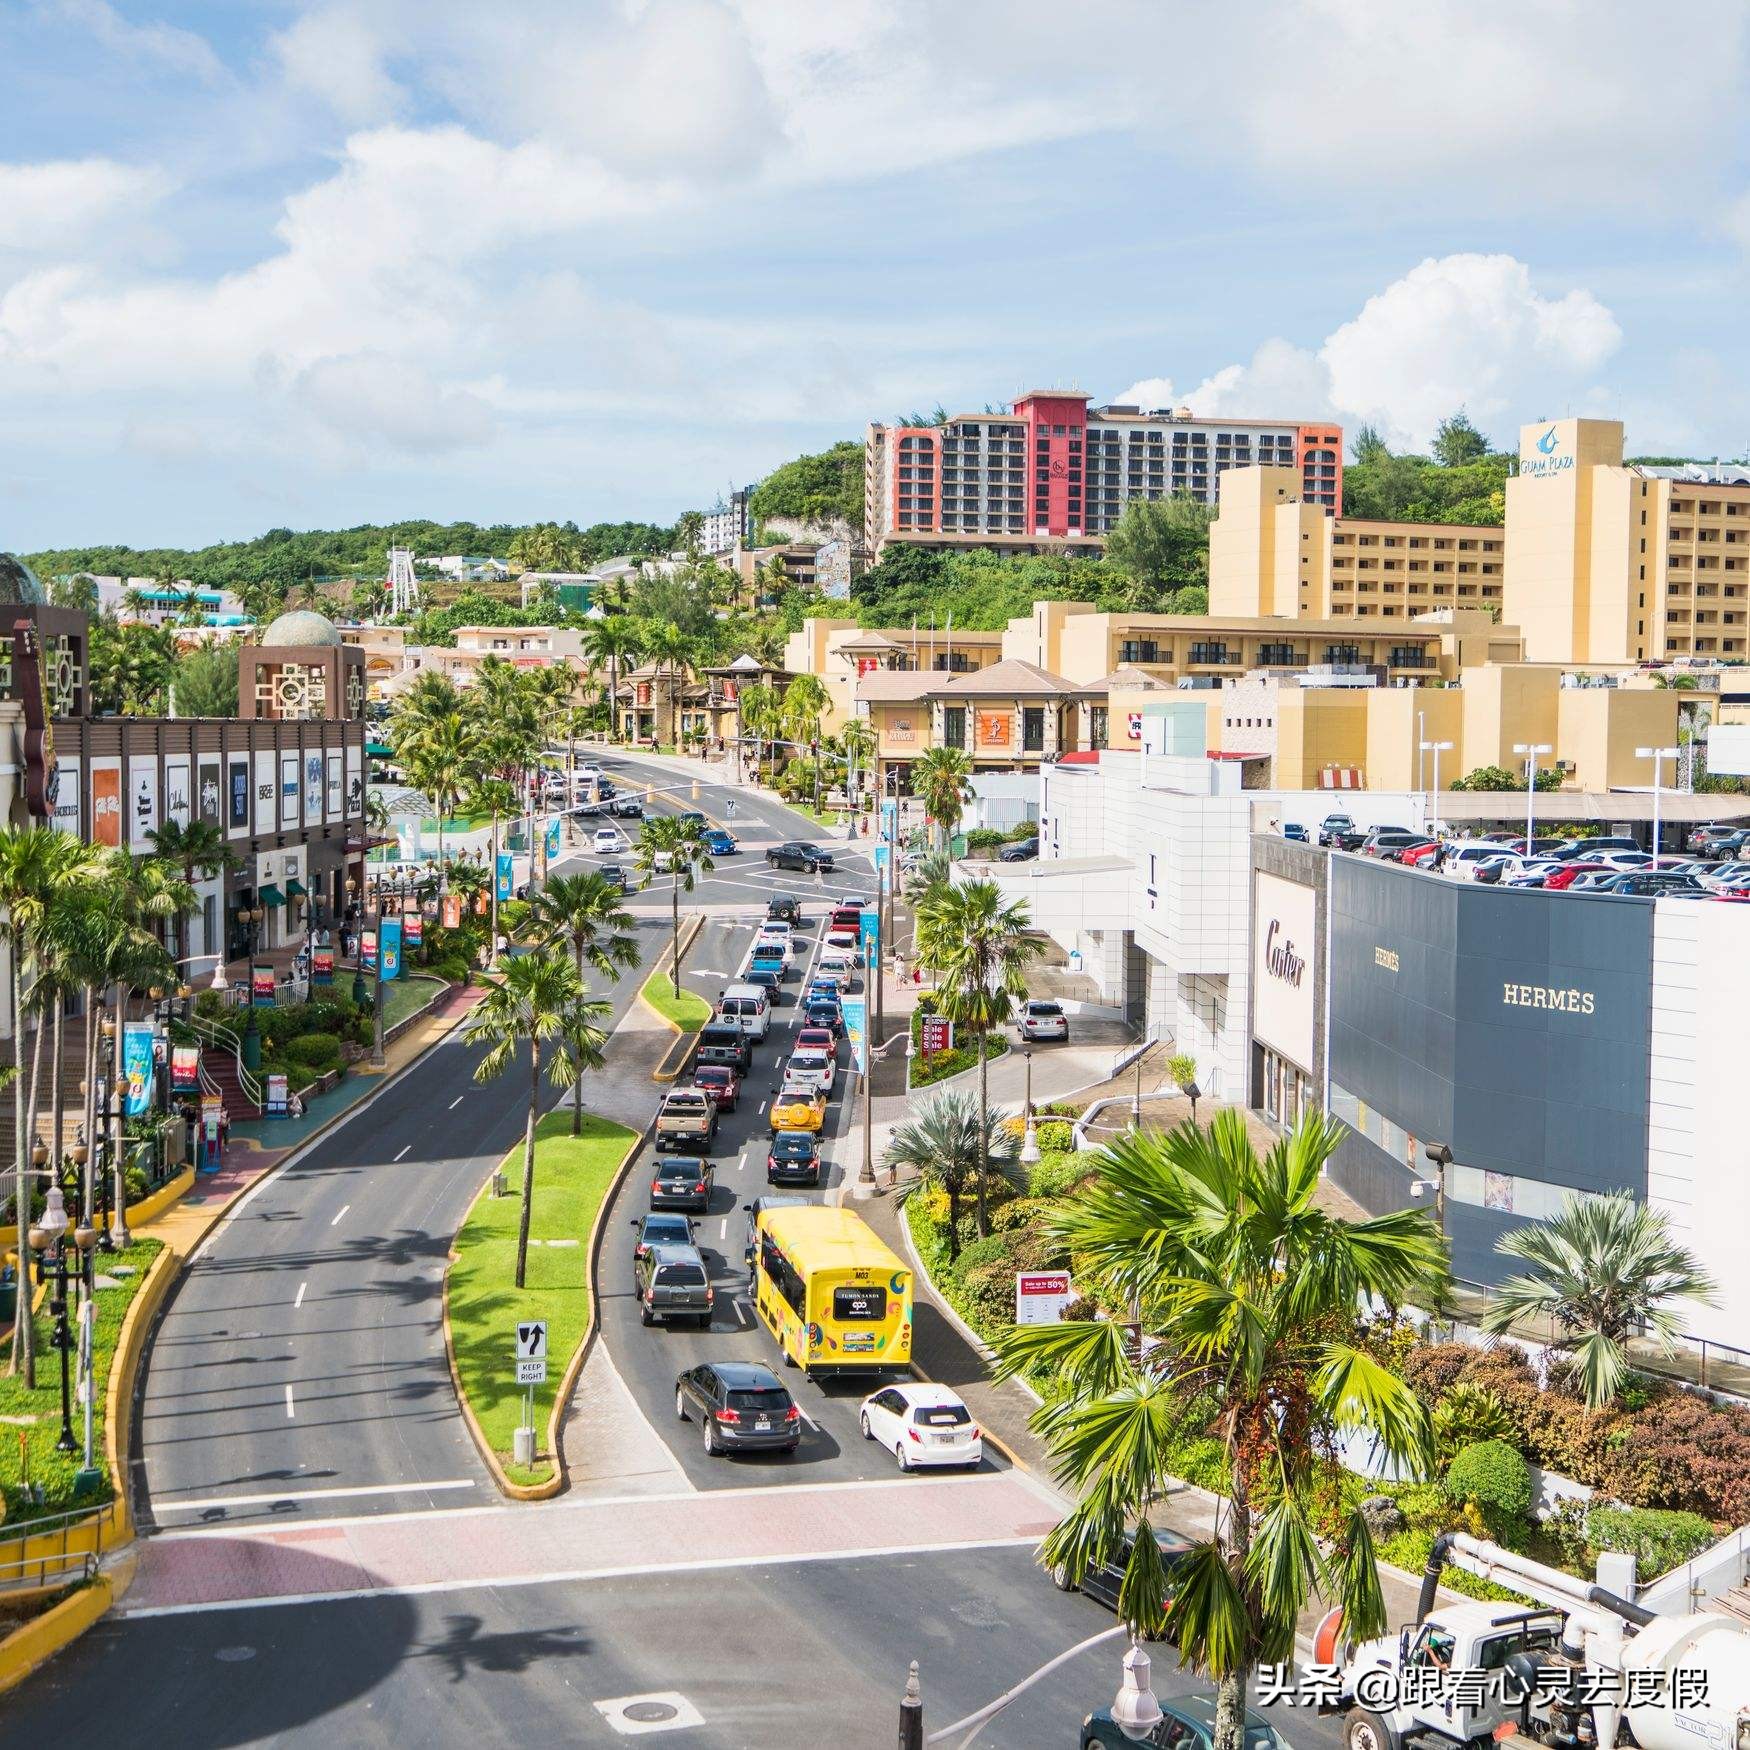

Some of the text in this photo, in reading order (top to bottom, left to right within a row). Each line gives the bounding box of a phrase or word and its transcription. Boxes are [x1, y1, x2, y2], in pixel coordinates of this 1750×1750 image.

[1520, 456, 1575, 473] GUAM PLAZA
[1266, 919, 1305, 990] Cartier
[522, 1363, 542, 1371] KEEP
[521, 1373, 542, 1381] RIGHT
